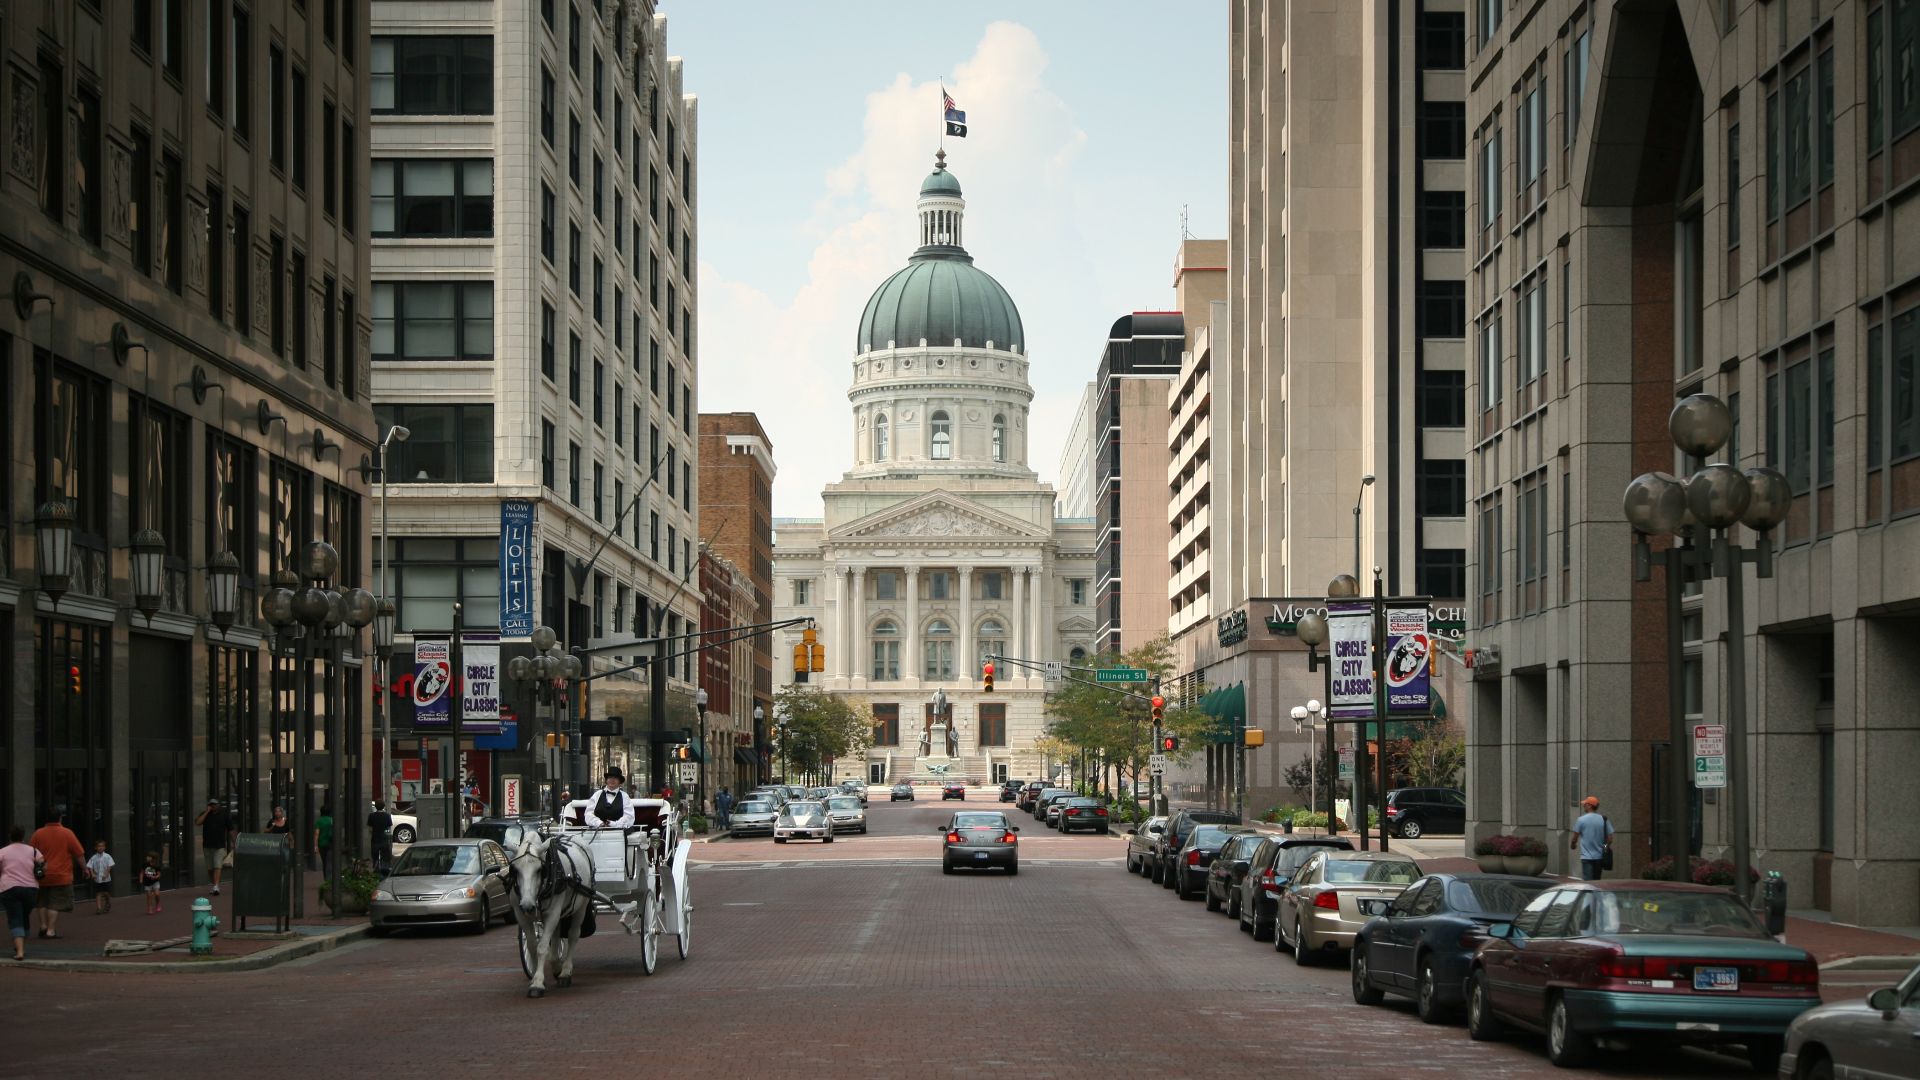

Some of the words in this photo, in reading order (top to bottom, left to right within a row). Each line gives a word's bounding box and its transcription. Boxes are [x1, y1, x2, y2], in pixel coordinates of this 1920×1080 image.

[509, 527, 522, 612] LOFTS
[506, 620, 527, 628] CALL
[1335, 641, 1367, 657] CIRCLE
[467, 666, 495, 680] CIRCLE
[1342, 660, 1363, 677] CITY
[472, 682, 491, 696] CITY
[1333, 679, 1372, 696] CLASSIC
[464, 698, 498, 712] CLASSIC
[1697, 728, 1706, 737] NO
[1697, 759, 1704, 771] 2
